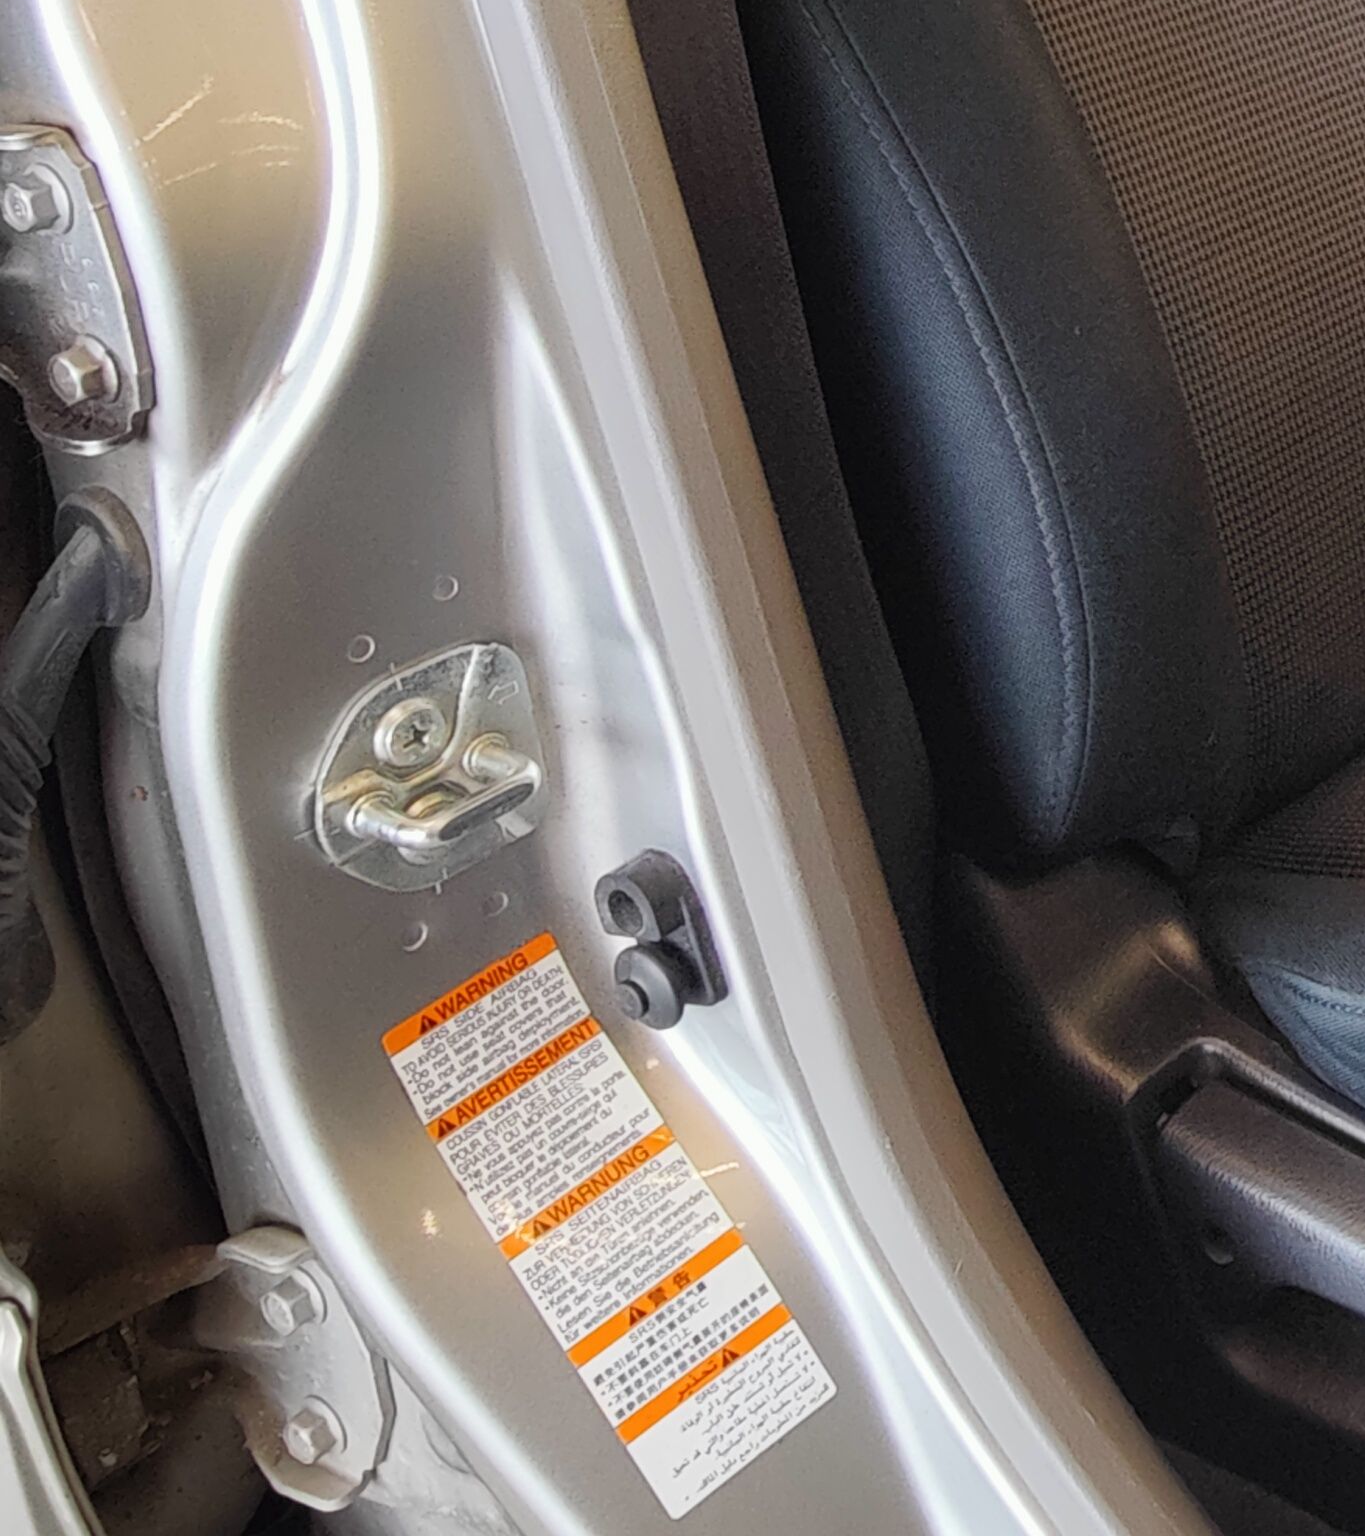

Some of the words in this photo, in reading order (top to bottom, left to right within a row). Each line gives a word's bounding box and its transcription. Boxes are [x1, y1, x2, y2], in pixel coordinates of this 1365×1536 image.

[418, 1024, 450, 1050] SRS
[451, 1001, 486, 1029] SIDE
[487, 967, 538, 1005] AIRBAG
[433, 951, 530, 1021] WARNING
[515, 984, 533, 1001] OR
[430, 1051, 451, 1071] not
[519, 994, 539, 1011] the
[435, 1062, 457, 1082] not
[456, 1047, 480, 1067] use
[480, 1029, 506, 1051] seat
[543, 989, 567, 1009] that
[451, 1018, 598, 1124] AVERTISSEMENT
[454, 1061, 481, 1084] side
[501, 1125, 522, 1145] OU
[544, 1142, 651, 1225] WARNUNG
